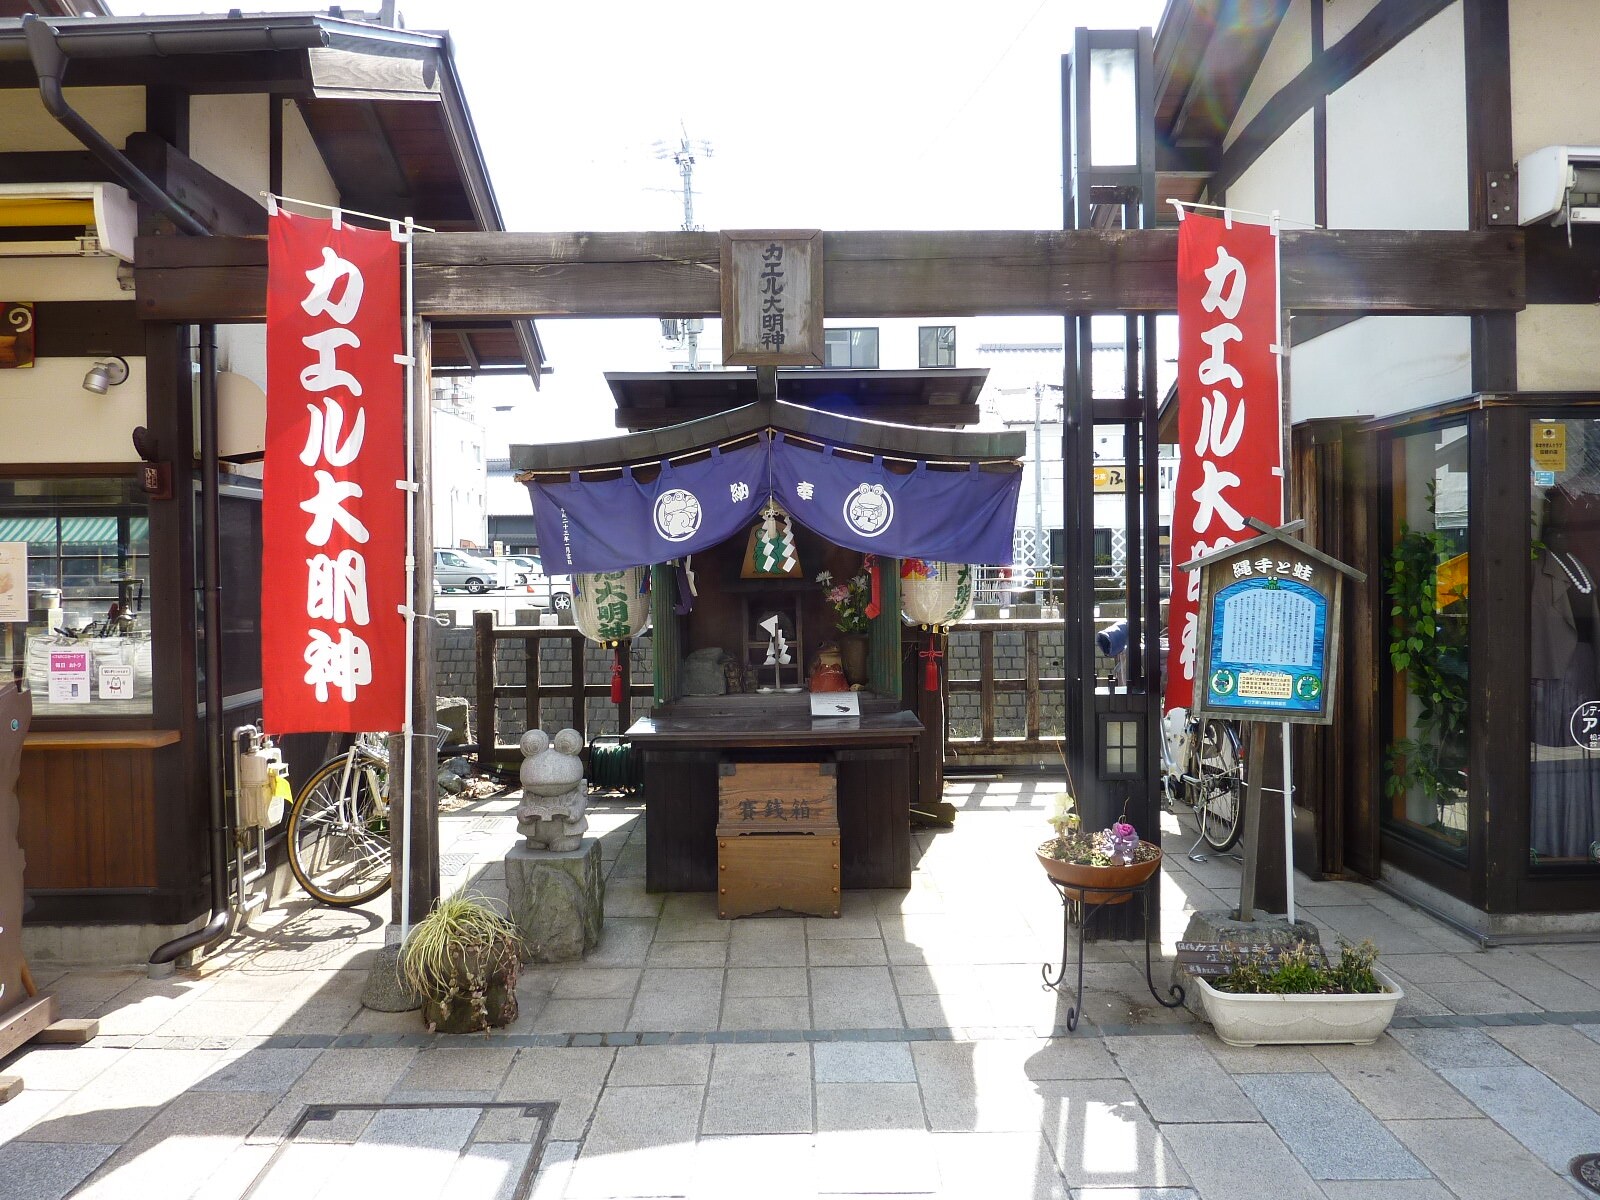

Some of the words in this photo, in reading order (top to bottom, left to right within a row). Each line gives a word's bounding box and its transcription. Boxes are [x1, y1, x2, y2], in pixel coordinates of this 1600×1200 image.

[760, 243, 786, 353] カエル大明神
[299, 245, 373, 703] カエル大明神
[729, 481, 750, 504] 納
[1231, 557, 1315, 582] 縄手と蛙
